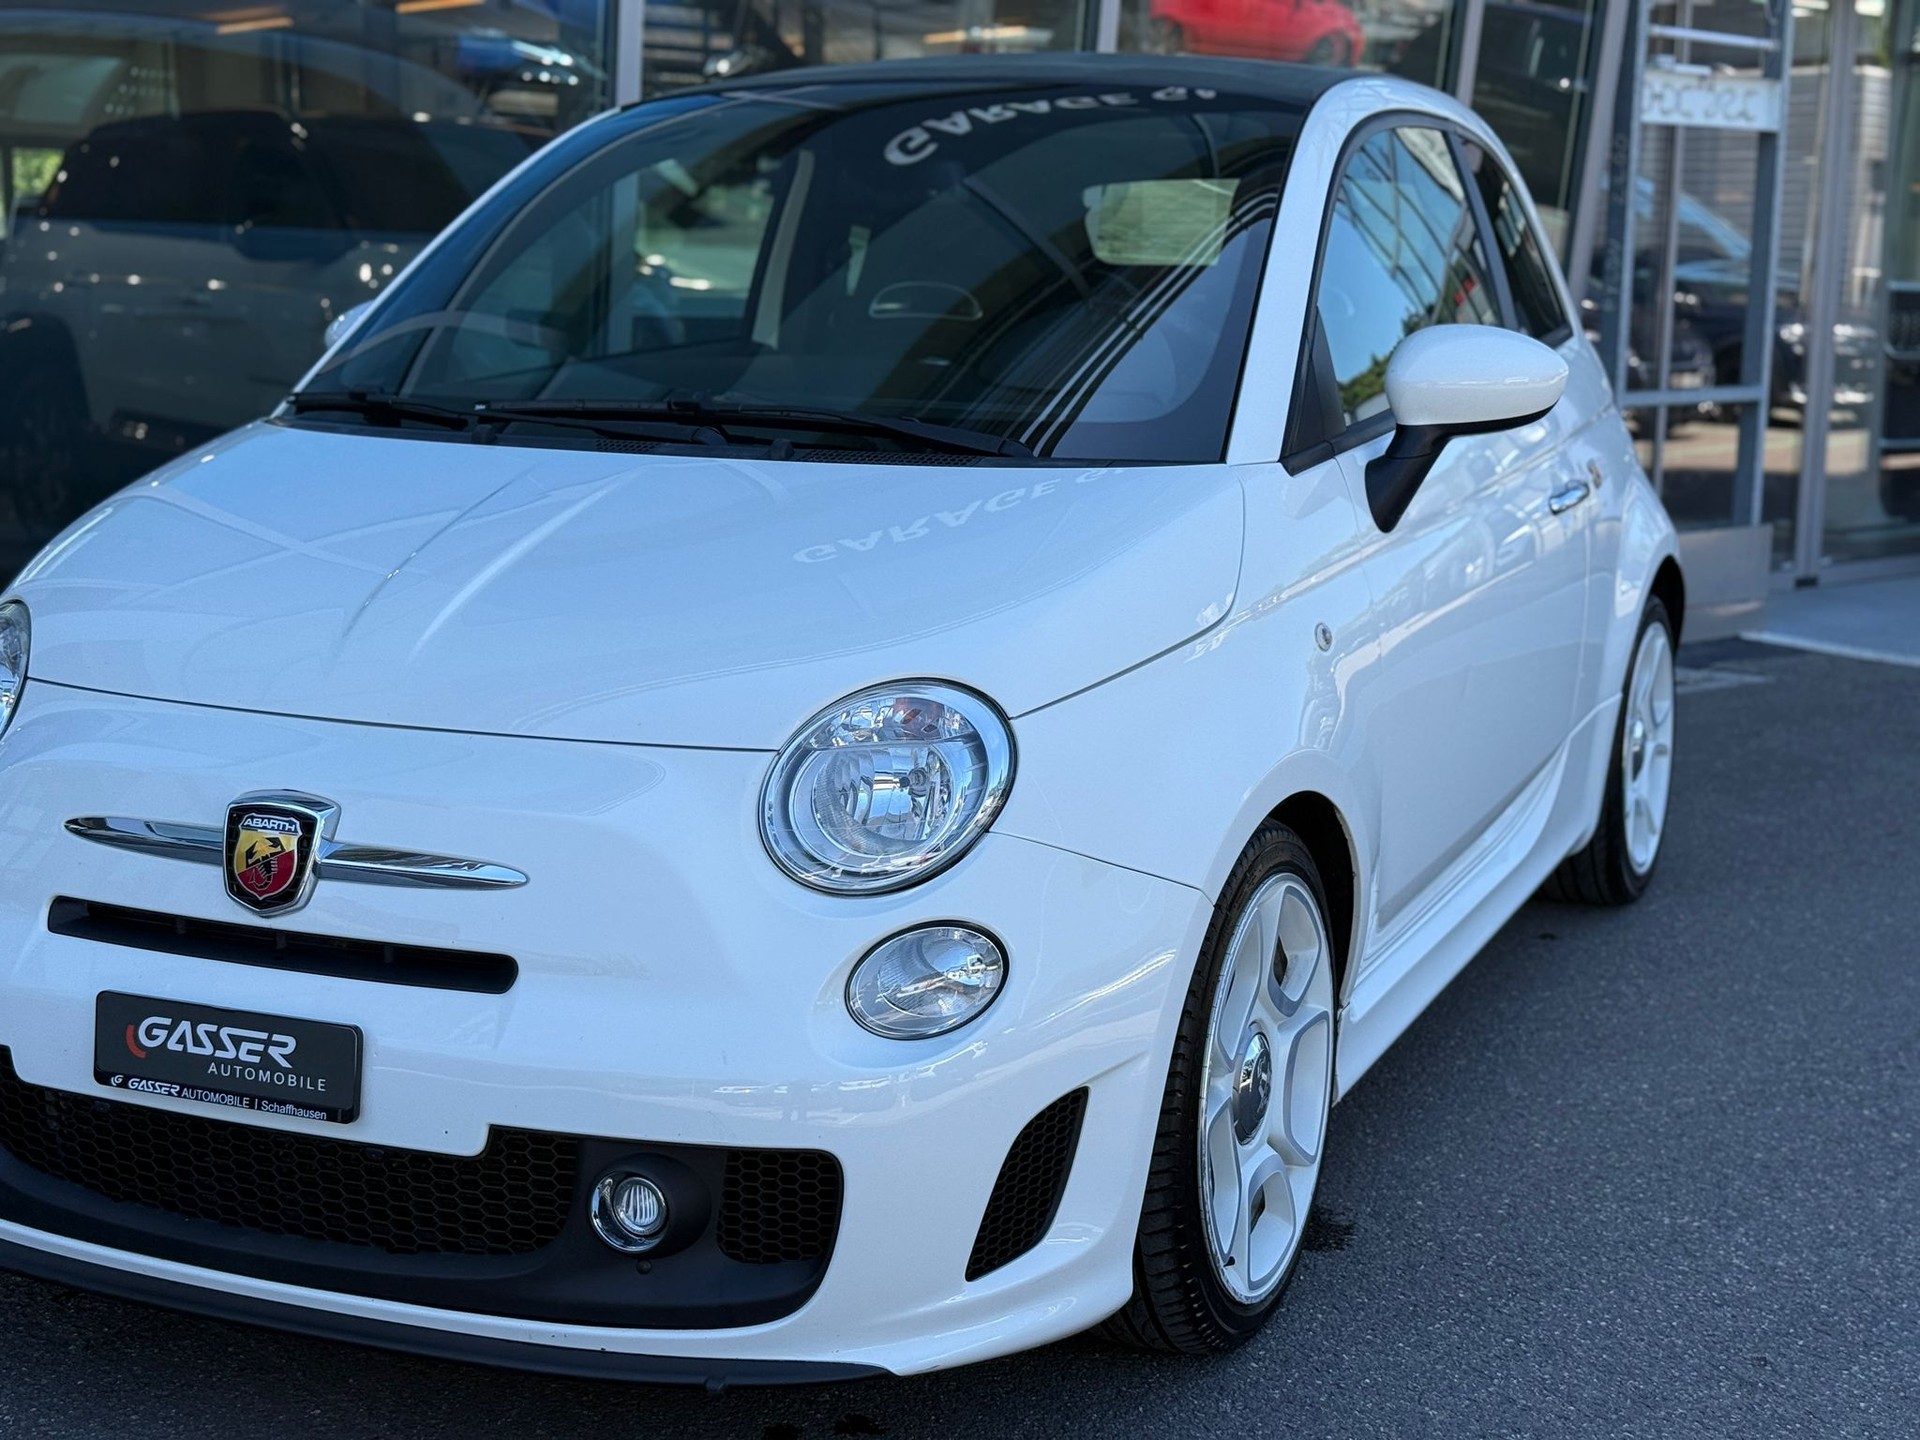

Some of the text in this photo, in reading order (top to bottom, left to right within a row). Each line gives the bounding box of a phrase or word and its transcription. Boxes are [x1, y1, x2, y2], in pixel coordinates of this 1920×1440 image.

[243, 818, 295, 831] ABARTH
[137, 1015, 296, 1068] GASSER
[208, 1062, 326, 1092] AUTOMOBILE
[128, 1078, 180, 1097] GASSER
[181, 1087, 250, 1108] AUTOMOBILE
[261, 1100, 327, 1120] Schaffhausen
